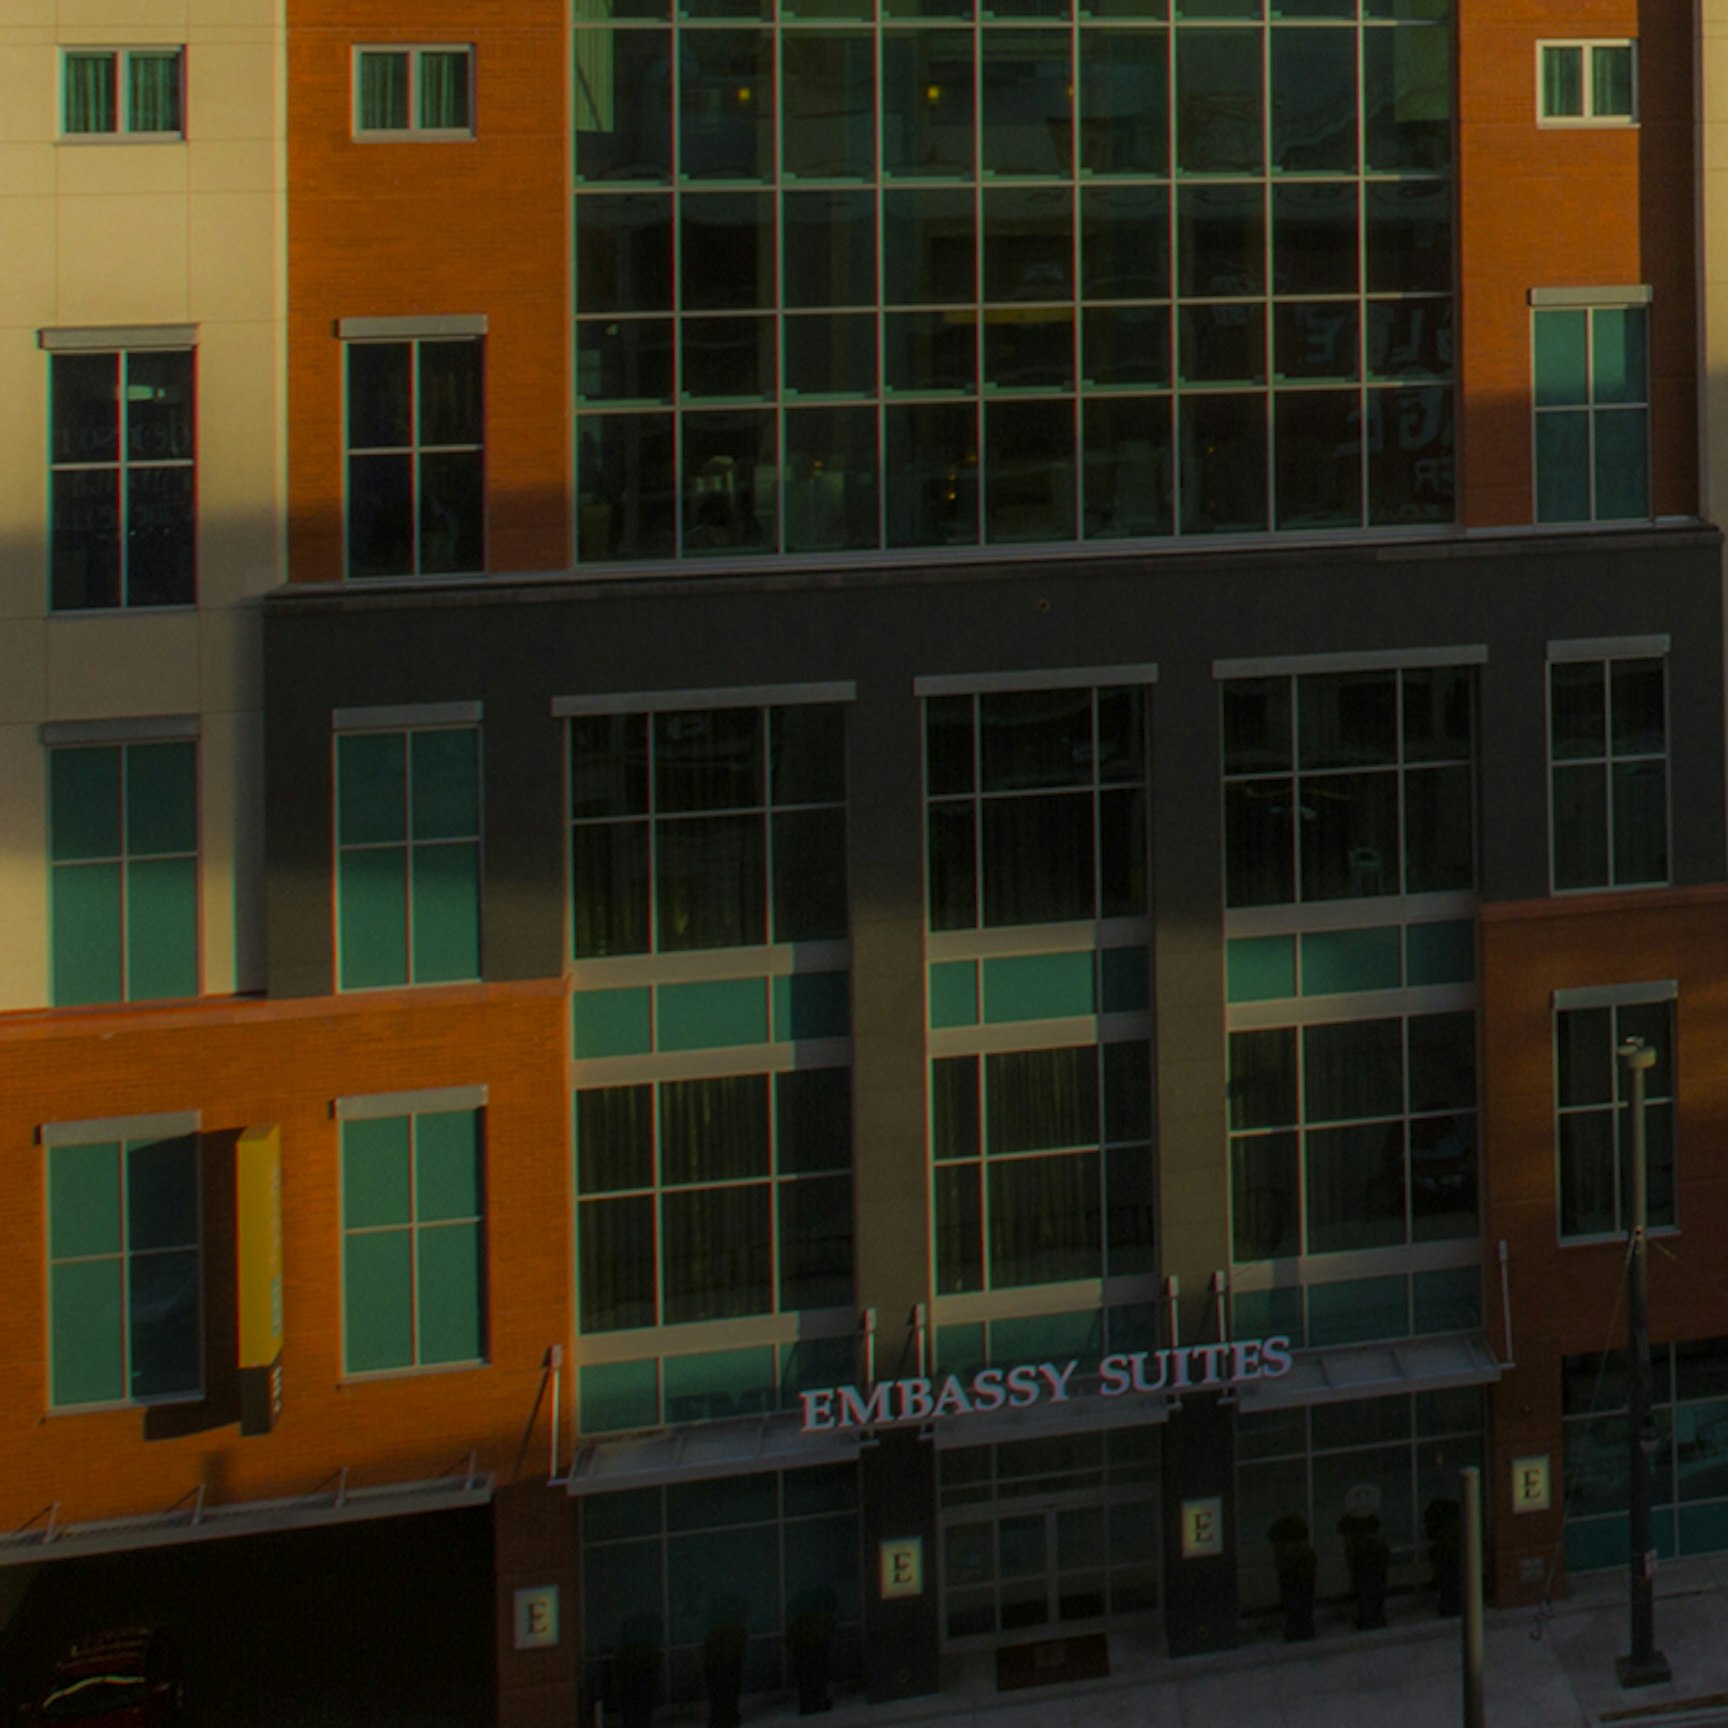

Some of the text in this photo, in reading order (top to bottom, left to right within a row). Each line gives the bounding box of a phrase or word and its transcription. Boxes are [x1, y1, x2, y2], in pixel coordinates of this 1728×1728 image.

[799, 1335, 1294, 1430] EMBASSY SUITES
[1522, 1469, 1542, 1501] E
[1193, 1512, 1214, 1543] E
[891, 1552, 914, 1584] E
[526, 1599, 549, 1634] E
